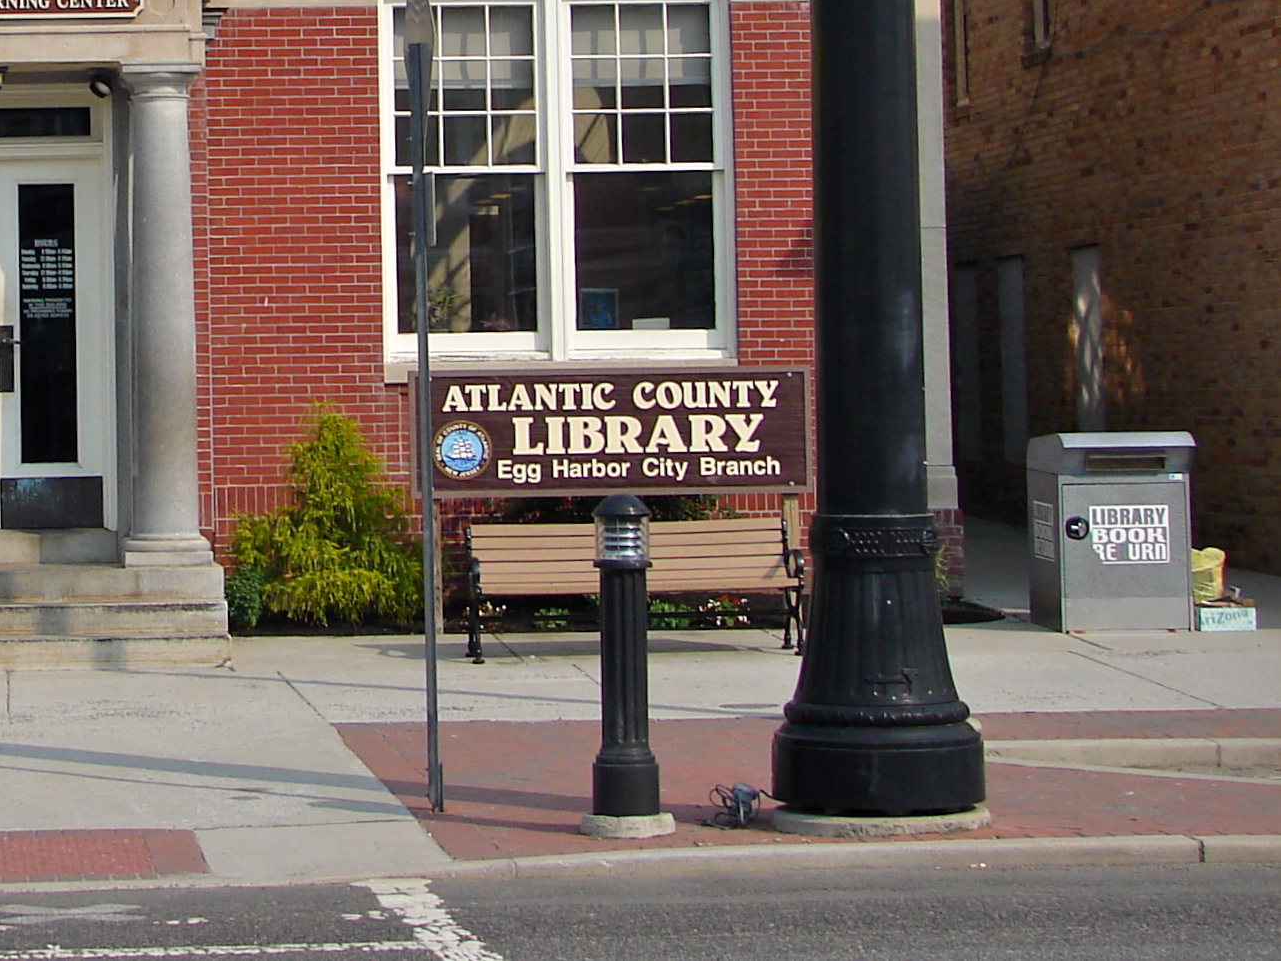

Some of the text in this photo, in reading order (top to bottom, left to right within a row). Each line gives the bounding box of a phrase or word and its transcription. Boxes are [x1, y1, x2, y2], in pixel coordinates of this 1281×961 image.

[442, 379, 780, 412] ATLANTIC COUNTY
[512, 413, 764, 456] LIBRARY
[497, 455, 781, 484] Egg Harbor City Branch
[1091, 507, 1166, 526] LIBRARY
[1092, 527, 1167, 544] BOOK
[1092, 542, 1167, 561] REURN
[1200, 609, 1248, 627] riZona
